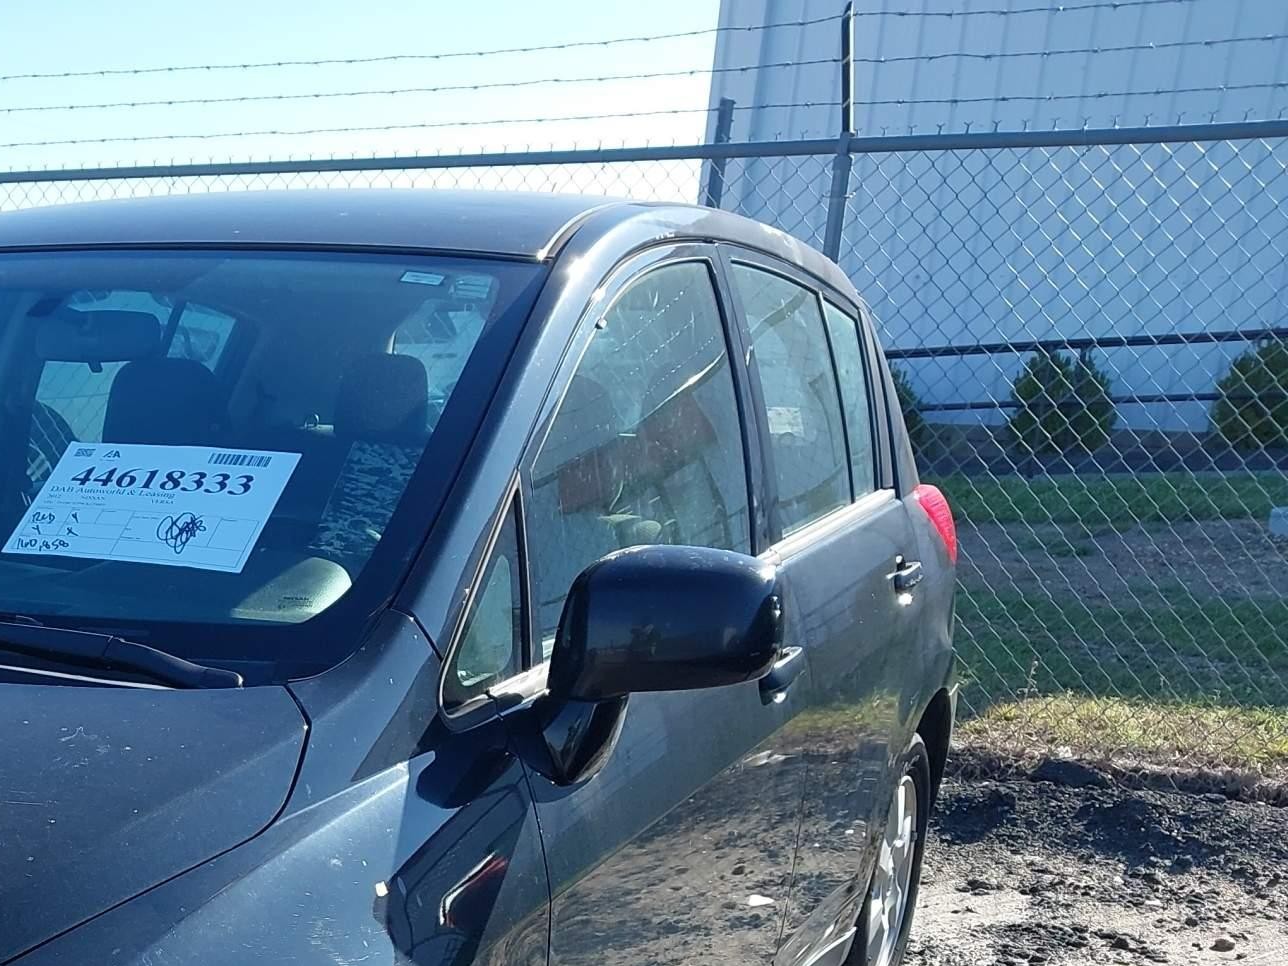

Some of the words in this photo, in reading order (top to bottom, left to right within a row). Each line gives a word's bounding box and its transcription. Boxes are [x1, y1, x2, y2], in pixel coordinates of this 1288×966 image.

[71, 466, 255, 496] 44618333
[75, 487, 126, 497] Autoworld
[138, 491, 176, 500] Leasing
